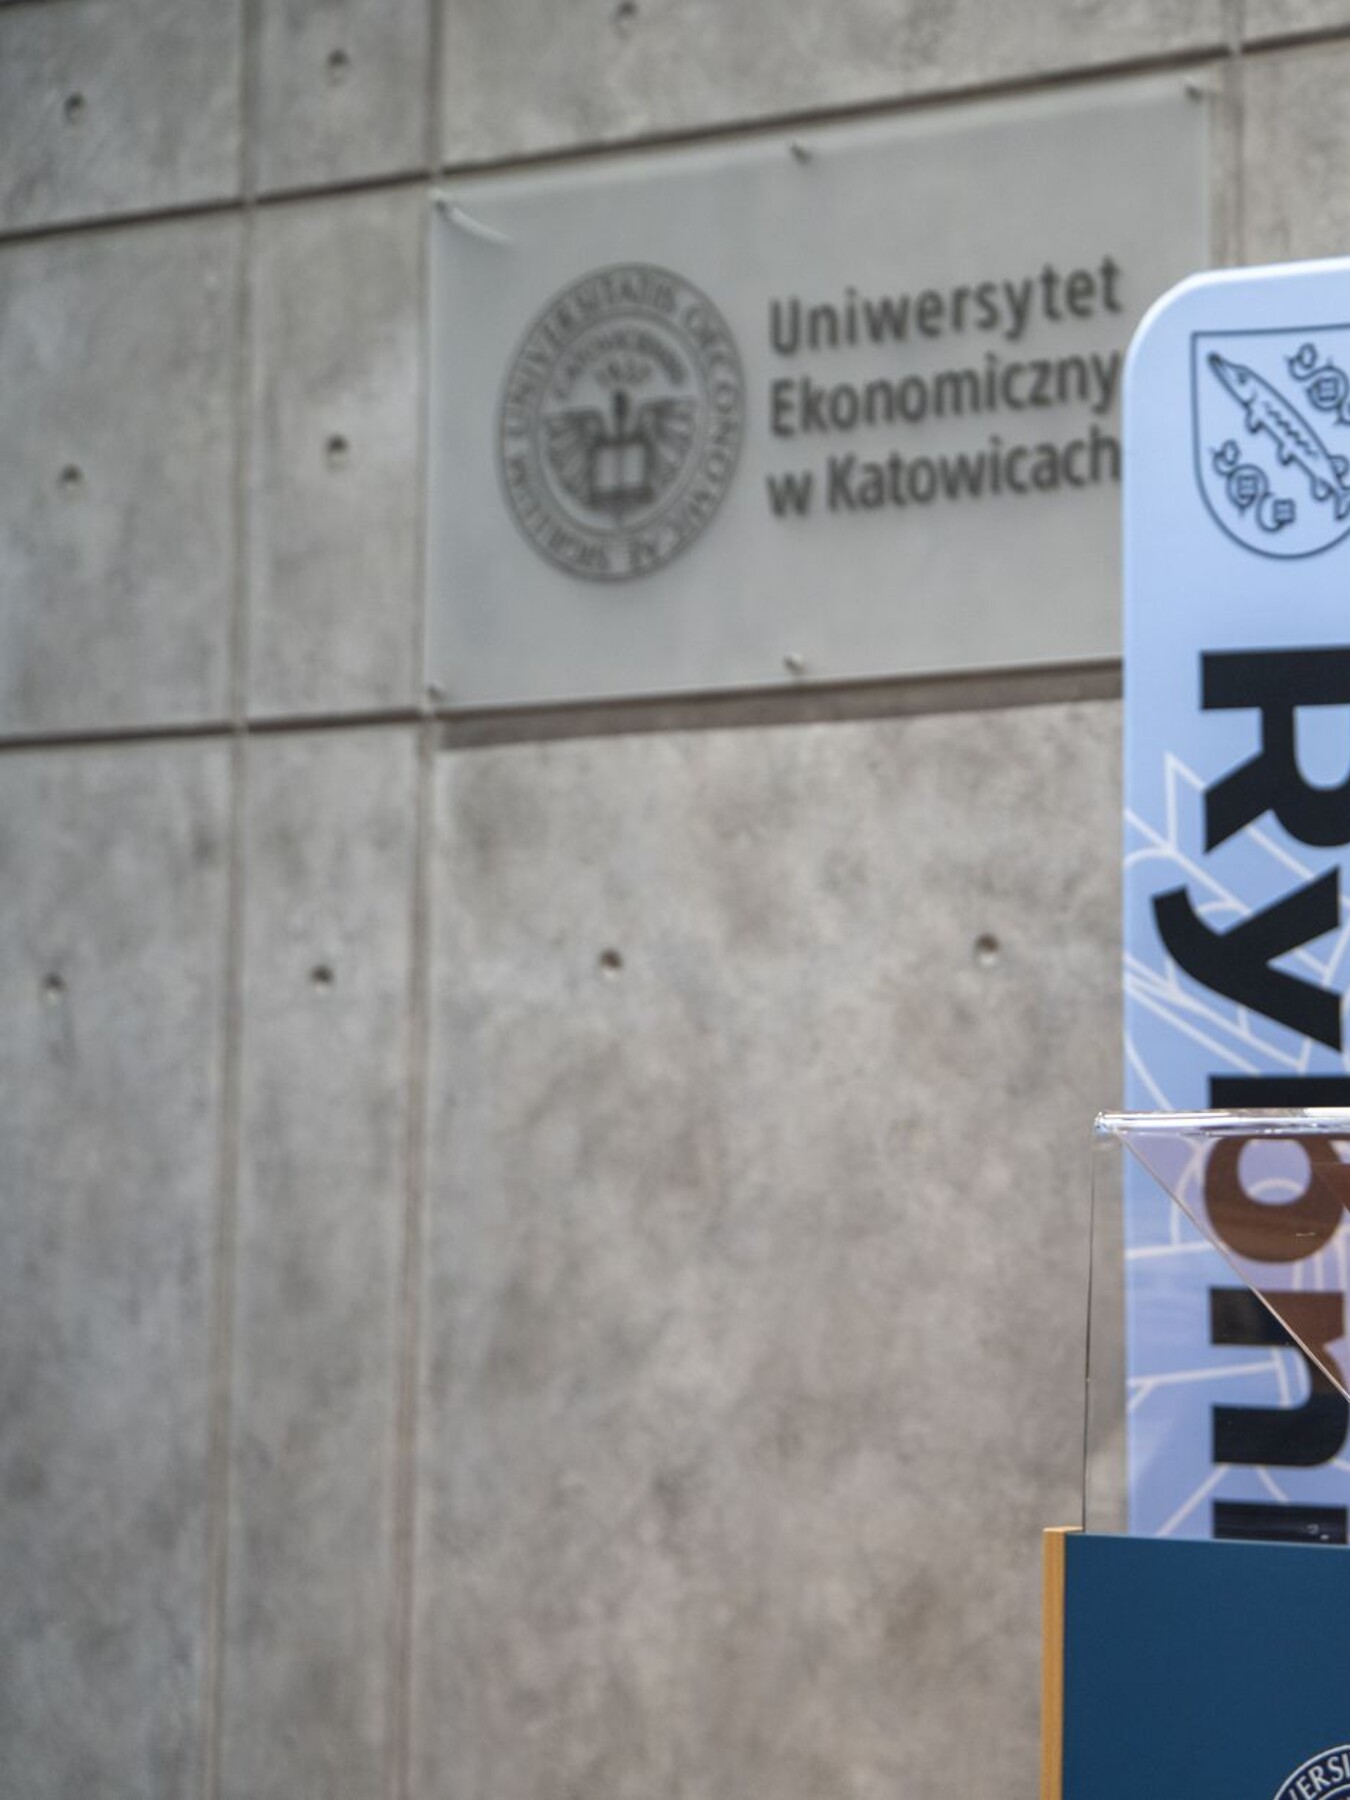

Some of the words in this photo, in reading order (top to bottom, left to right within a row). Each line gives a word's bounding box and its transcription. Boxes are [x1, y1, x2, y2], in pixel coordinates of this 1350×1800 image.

[769, 254, 1123, 356] Uniwersytet
[769, 350, 1120, 438] Ekonomiczny
[765, 470, 813, 517] w
[826, 425, 1122, 513] Katowicach
